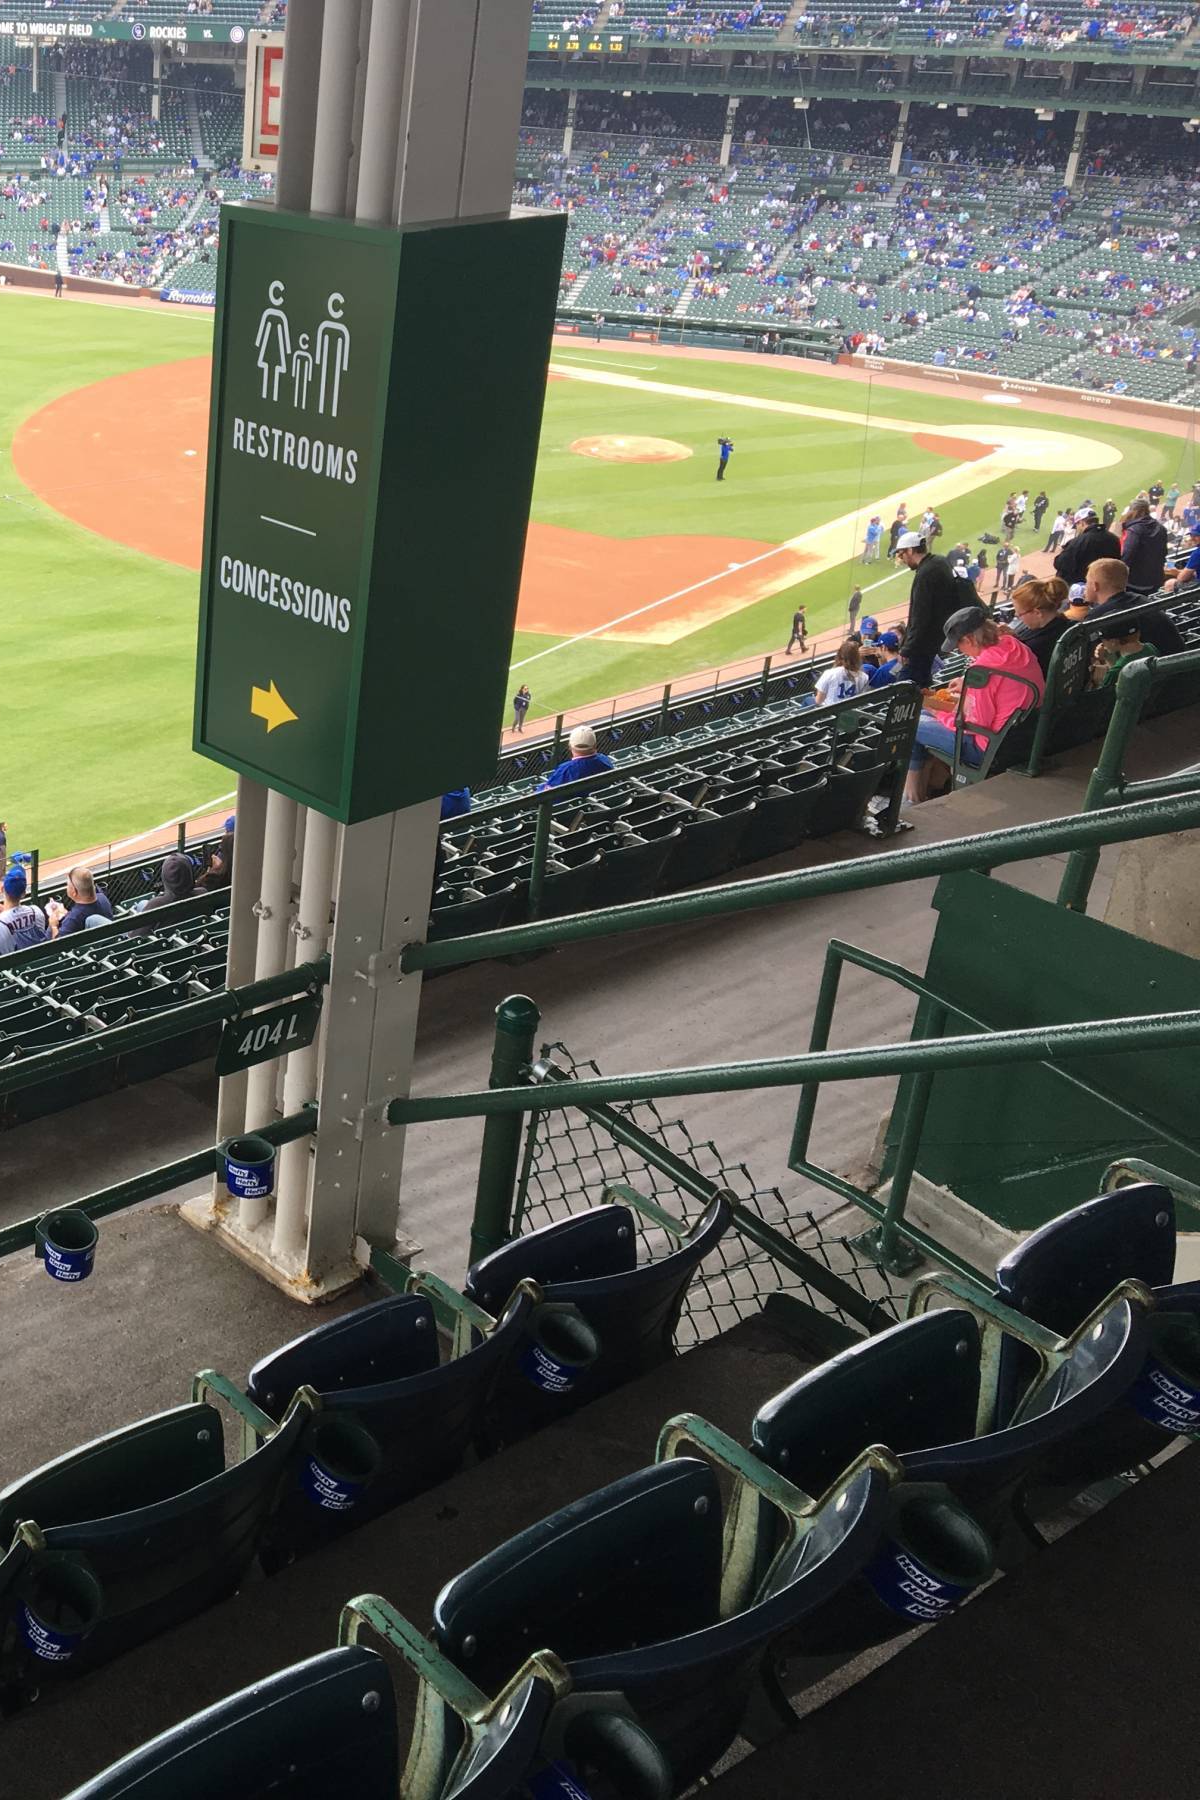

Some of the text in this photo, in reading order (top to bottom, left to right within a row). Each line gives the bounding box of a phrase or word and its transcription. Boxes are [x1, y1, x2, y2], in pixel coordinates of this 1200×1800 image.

[16, 22, 28, 34] TO
[29, 23, 68, 35] WRIGLEY
[69, 24, 93, 36] FIELD
[149, 27, 188, 39] ROCKIES
[167, 290, 214, 304] Reynolds
[232, 417, 359, 485] RESTROOMS
[220, 555, 351, 634] CONCESSIONS
[838, 683, 856, 698] 14
[235, 1177, 259, 1187] Hefty
[49, 1256, 72, 1271] Hefty
[55, 1270, 81, 1280] Hefty
[536, 1366, 568, 1384] Hefty
[1150, 1372, 1193, 1403] Hefty
[1154, 1396, 1200, 1421] Hefty
[314, 1482, 348, 1501] Hefty
[896, 1555, 941, 1591] Hefty
[899, 1582, 949, 1608] Hefty
[28, 1629, 60, 1652] Hefty
